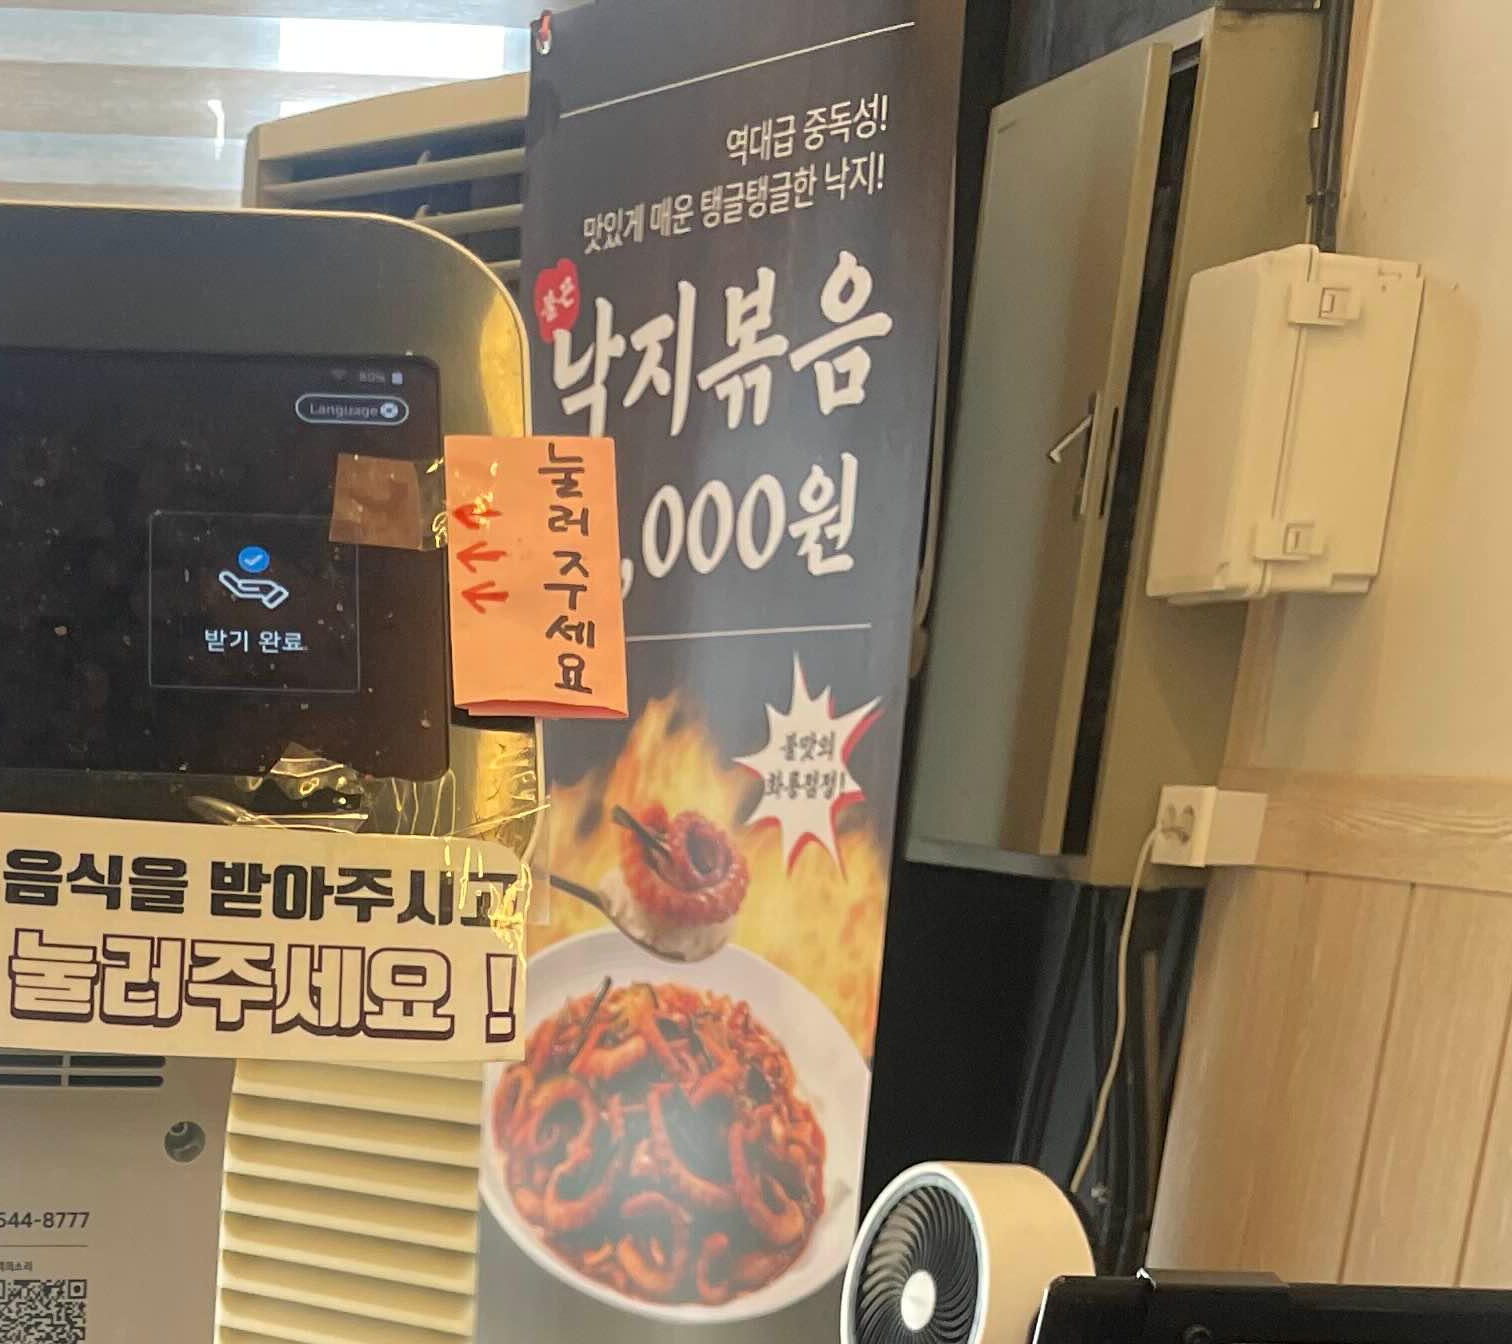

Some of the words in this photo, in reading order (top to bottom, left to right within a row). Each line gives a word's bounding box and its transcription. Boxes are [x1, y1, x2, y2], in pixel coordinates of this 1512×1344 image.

[727, 115, 796, 166] 역대급
[803, 93, 888, 151] 중독성!
[584, 203, 645, 254] 맛있게
[650, 194, 694, 237] 매운
[701, 163, 818, 229] 탱글탱글한
[824, 151, 885, 200] 낙지!
[552, 250, 893, 437] 낙지볶음
[310, 402, 378, 418] Language
[538, 442, 595, 694] 눌러주세요
[204, 629, 248, 653] 받기
[258, 630, 305, 653] 완료
[2, 848, 189, 914] 음식을
[209, 860, 523, 928] 받아주시고
[7, 927, 456, 1041] 눌러주세요
